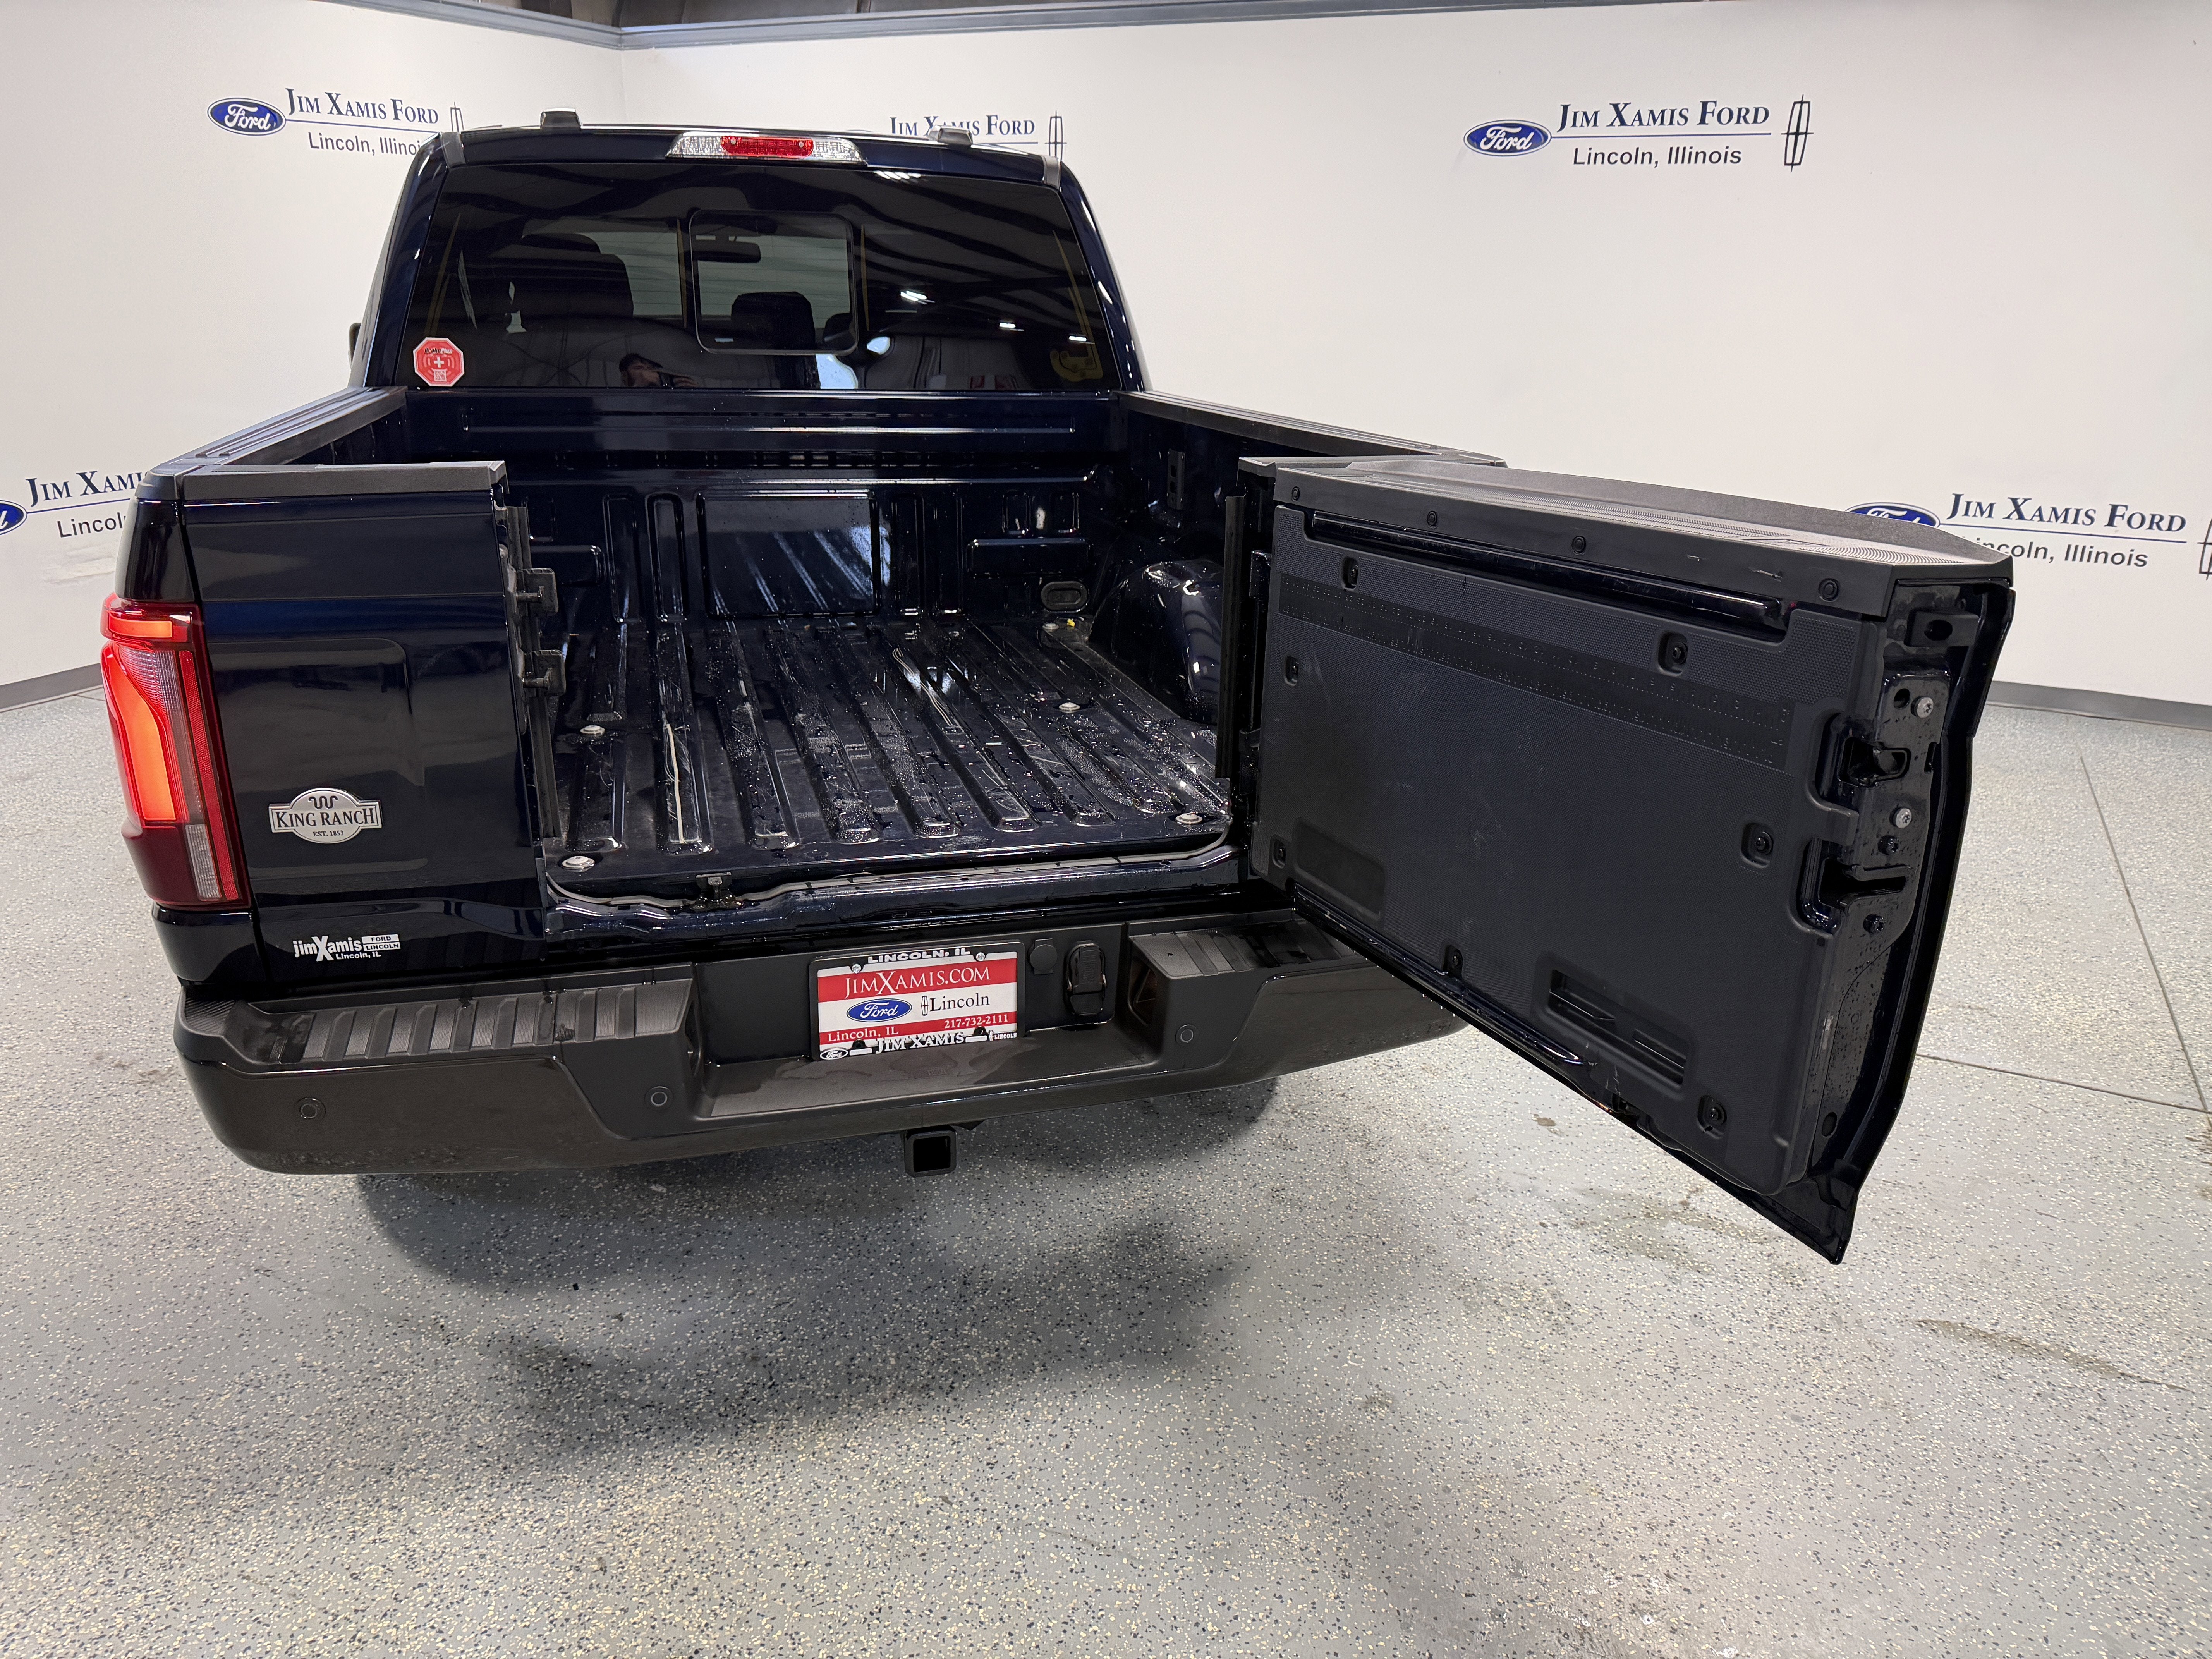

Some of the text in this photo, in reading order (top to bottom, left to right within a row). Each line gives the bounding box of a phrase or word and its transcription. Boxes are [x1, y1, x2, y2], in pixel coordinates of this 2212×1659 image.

[225, 104, 270, 131] Ford
[285, 88, 438, 124] JIM XAMIS FORD
[1556, 100, 1770, 133] JIM XAMIS FORD
[986, 114, 1036, 135] FORD
[308, 132, 420, 156] Lincoln, Illinoi
[1480, 126, 1532, 150] Ford
[1573, 146, 1742, 168] Lincoln, Illinois
[26, 471, 148, 507] JIM XAMI
[57, 512, 126, 538] Lincol
[1946, 493, 1996, 520] JIM
[2003, 497, 2097, 526] XAMIS
[2104, 503, 2187, 533] FORD
[2064, 544, 2148, 567] Illinois
[275, 808, 376, 828] KING RANCH
[844, 966, 991, 999] JIMXAMIS.COM
[860, 993, 990, 1018] Ford Lincoln
[944, 1013, 1009, 1029] 217-732-2111
[828, 1026, 899, 1042] Lincoln, IL
[875, 1032, 965, 1054] JIM XAMIS
